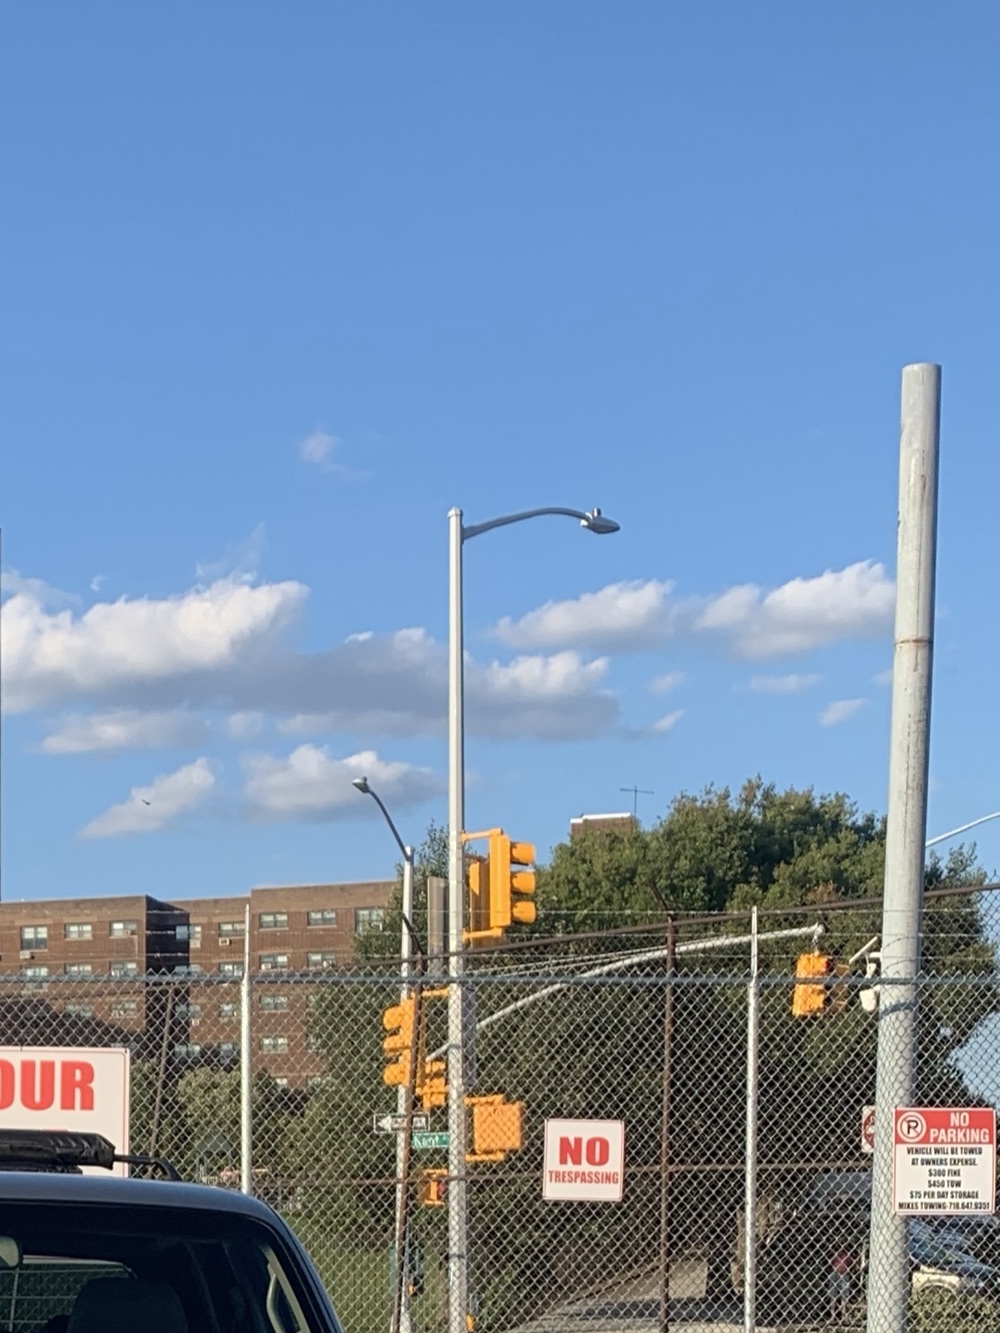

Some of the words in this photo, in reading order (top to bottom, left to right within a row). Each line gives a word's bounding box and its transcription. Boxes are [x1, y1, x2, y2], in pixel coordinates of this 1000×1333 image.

[950, 1113, 970, 1127] NO
[929, 1128, 990, 1143] PARKING
[559, 1136, 610, 1167] NO
[906, 1146, 933, 1156] VEHICLE
[934, 1146, 949, 1156] WILL
[950, 1146, 959, 1156] BE
[960, 1146, 983, 1156] TOWED
[911, 1157, 919, 1167] AT
[920, 1157, 948, 1167] OWNERS
[548, 1170, 619, 1185] TRESPASSING
[947, 1168, 961, 1178] FINE
[947, 1179, 962, 1189] TOW
[909, 1190, 922, 1200] $75
[923, 1190, 935, 1200] PER
[936, 1190, 949, 1200] DAY
[950, 1190, 980, 1200] STORAGE
[898, 1201, 919, 1211] MIKES
